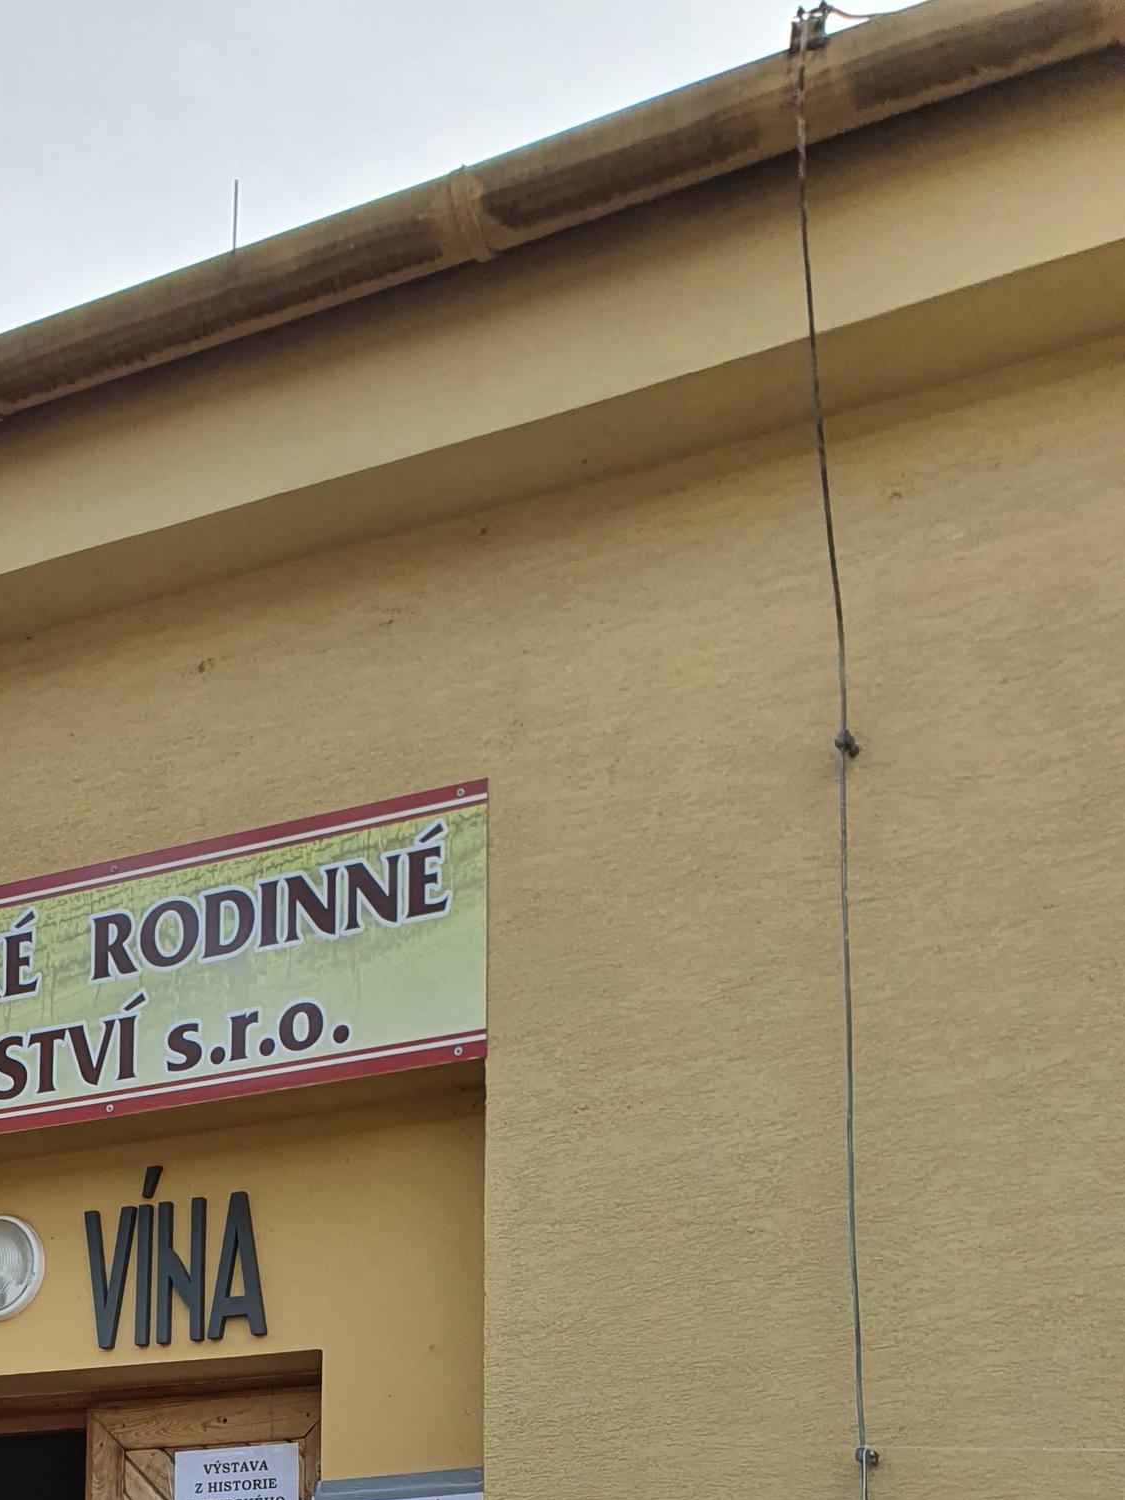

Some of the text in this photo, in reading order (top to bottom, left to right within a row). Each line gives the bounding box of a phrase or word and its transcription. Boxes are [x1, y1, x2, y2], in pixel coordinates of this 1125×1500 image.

[89, 822, 451, 983] RODINNÉ
[166, 1001, 351, 1072] s.r.o.
[85, 1165, 267, 1350] VÍNA
[195, 1477, 277, 1494] Z HISTORIE
[203, 1458, 269, 1475] VÝSTAVA
